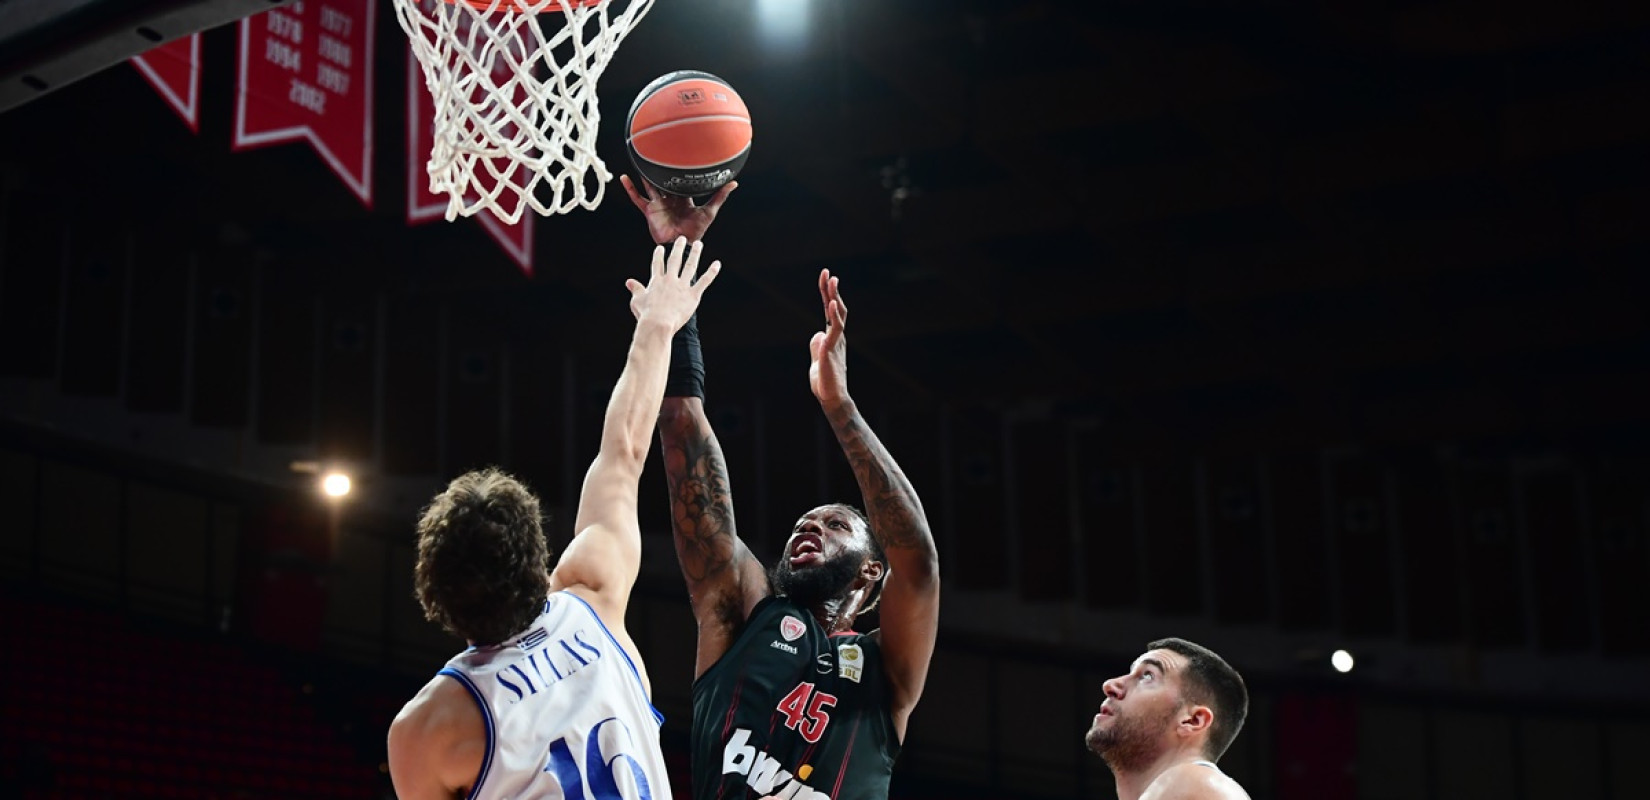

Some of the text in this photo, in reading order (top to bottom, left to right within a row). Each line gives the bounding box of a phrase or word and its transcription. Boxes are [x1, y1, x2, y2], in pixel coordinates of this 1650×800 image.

[266, 37, 300, 71] 1994
[495, 629, 602, 704] SYLLAS
[776, 681, 838, 743] 45
[543, 717, 652, 800] 16
